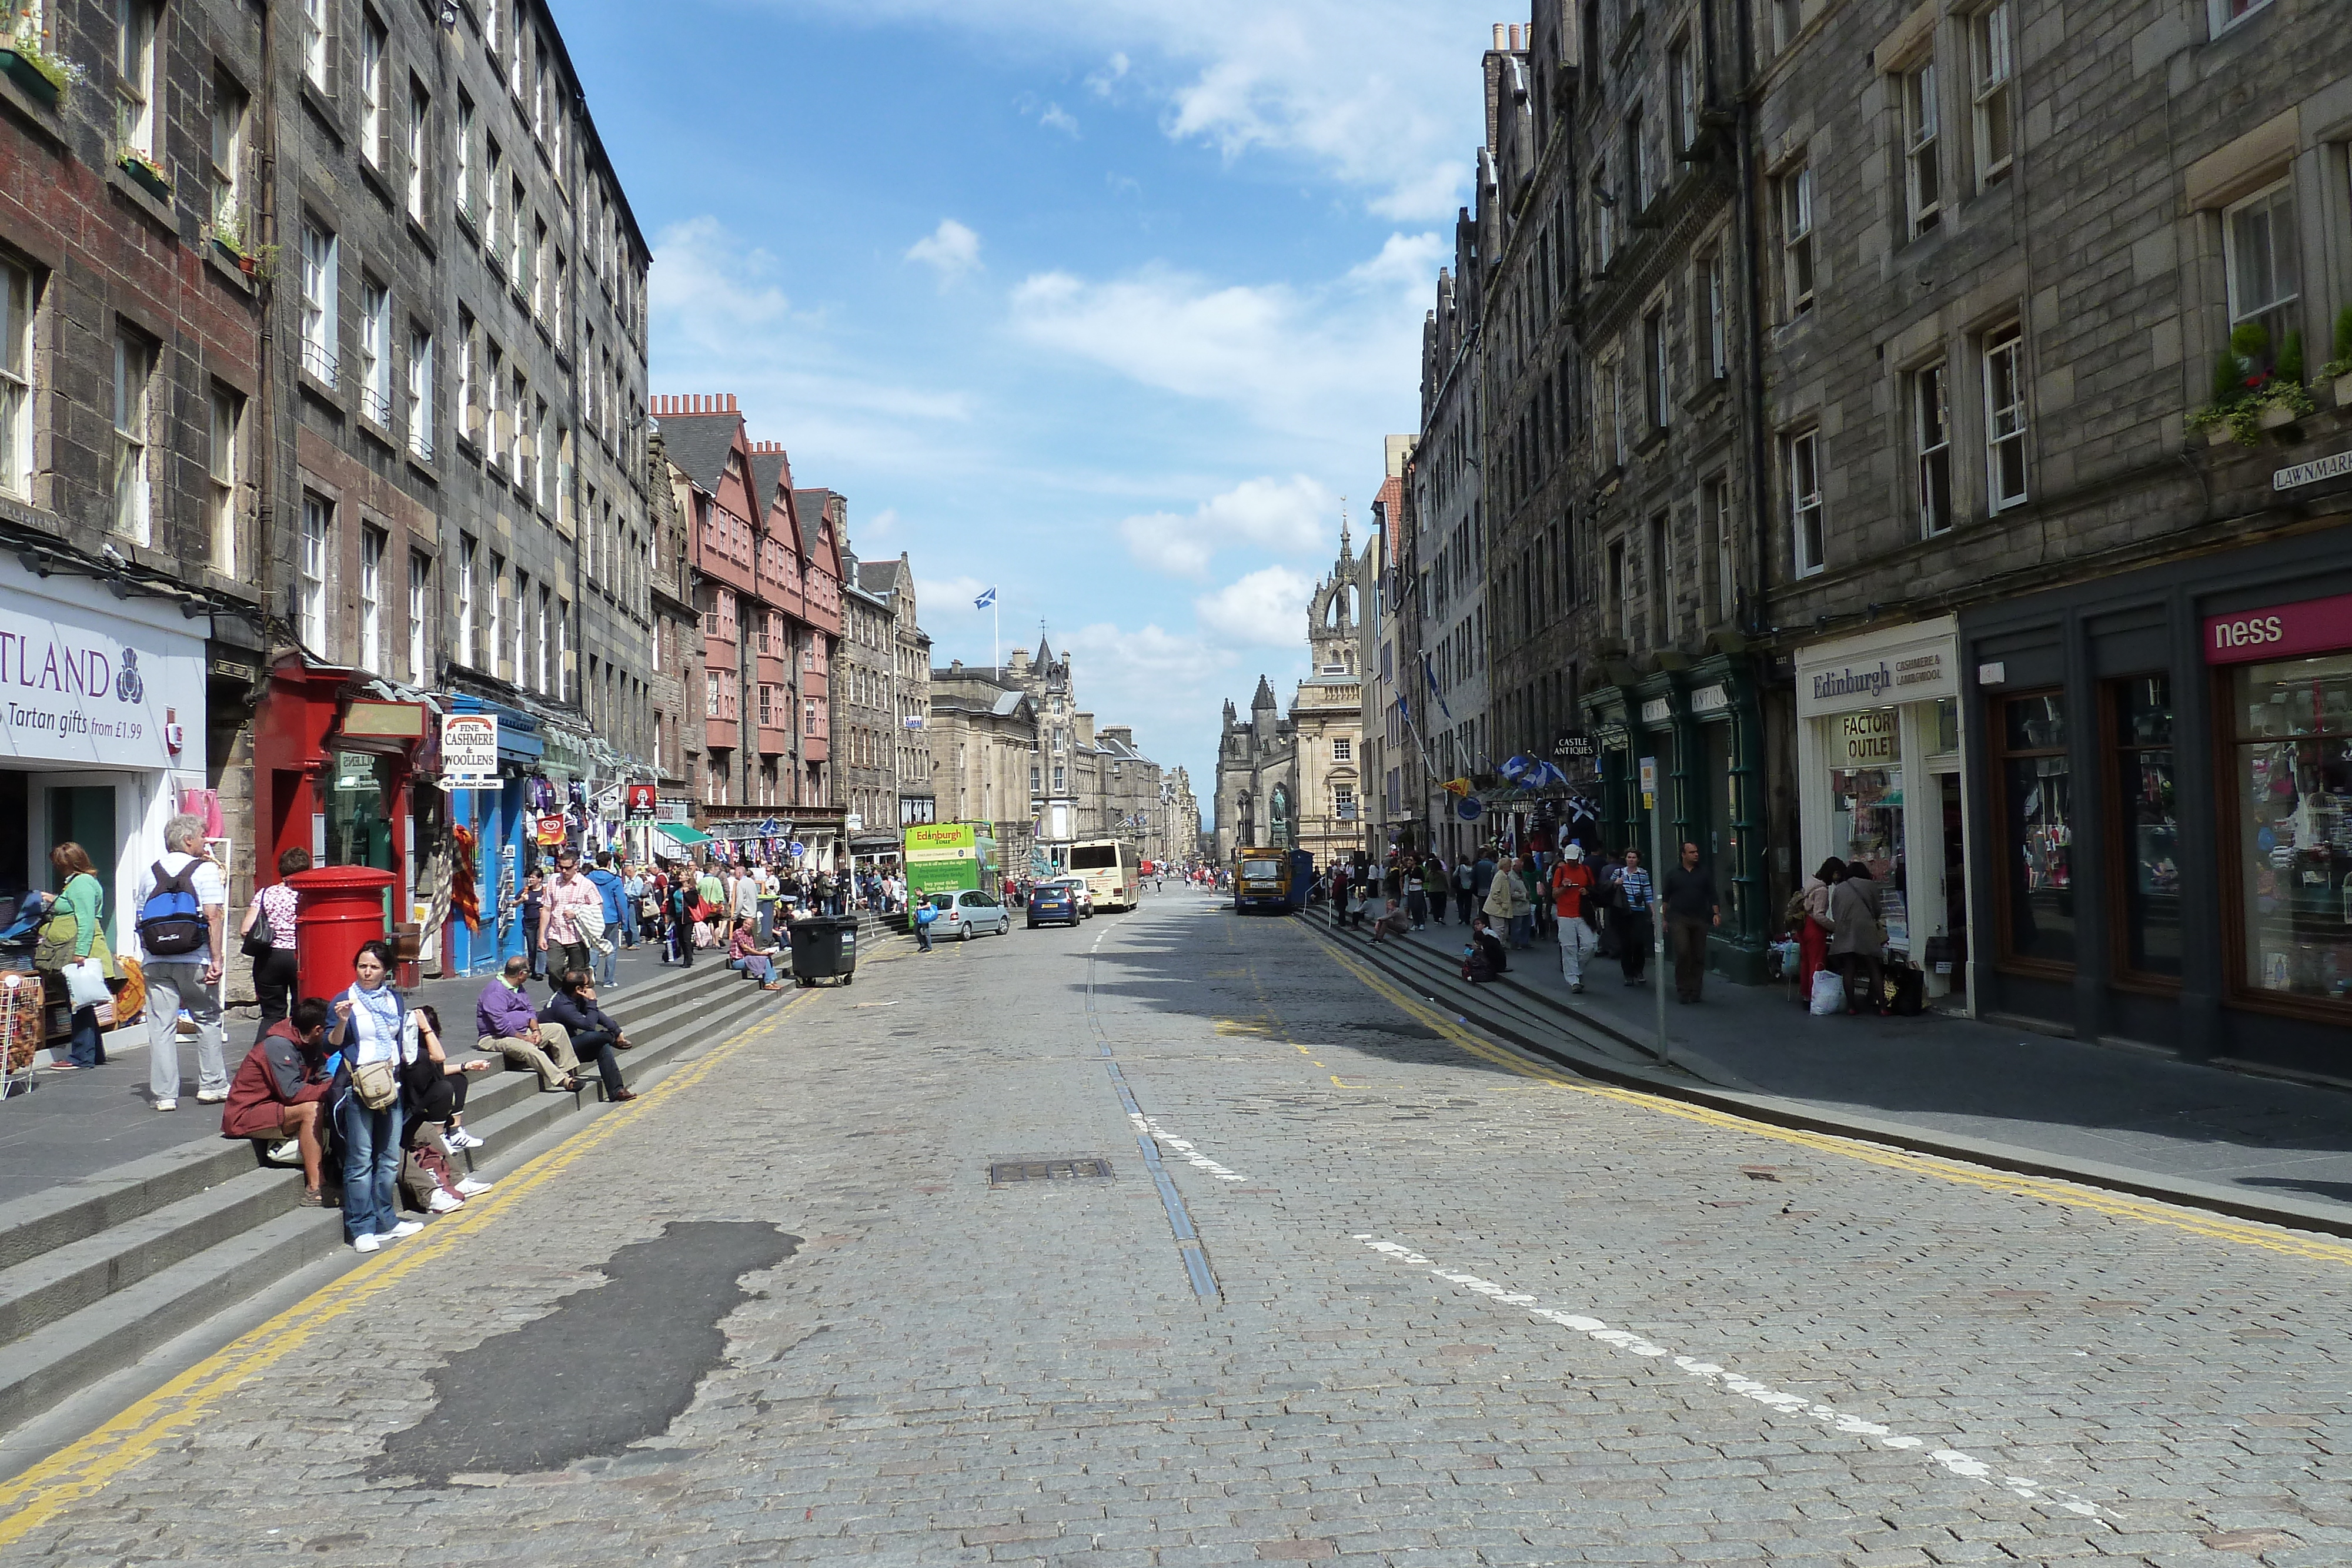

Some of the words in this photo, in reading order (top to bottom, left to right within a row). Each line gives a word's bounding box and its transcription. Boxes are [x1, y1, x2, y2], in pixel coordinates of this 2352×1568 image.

[2216, 616, 2283, 648] ness
[0, 631, 109, 697] TLAND
[1813, 662, 1890, 699] Edinburgh
[1896, 656, 1935, 671] CASHMERE
[1935, 654, 1940, 665] &
[1896, 669, 1942, 685] LAMBSWOOL
[9, 702, 55, 730] Tartan
[59, 710, 87, 738] gifts
[91, 718, 112, 736] from
[115, 721, 142, 740] £1.99
[1843, 712, 1897, 735] FACTORY
[445, 733, 494, 745] CASHMERE
[1558, 738, 1588, 746] CASTLE
[1849, 736, 1894, 758] OUTLET
[445, 755, 493, 765] WOOLLENS
[1553, 746, 1593, 755] ANTIQUES
[917, 829, 961, 841] Edinburgh
